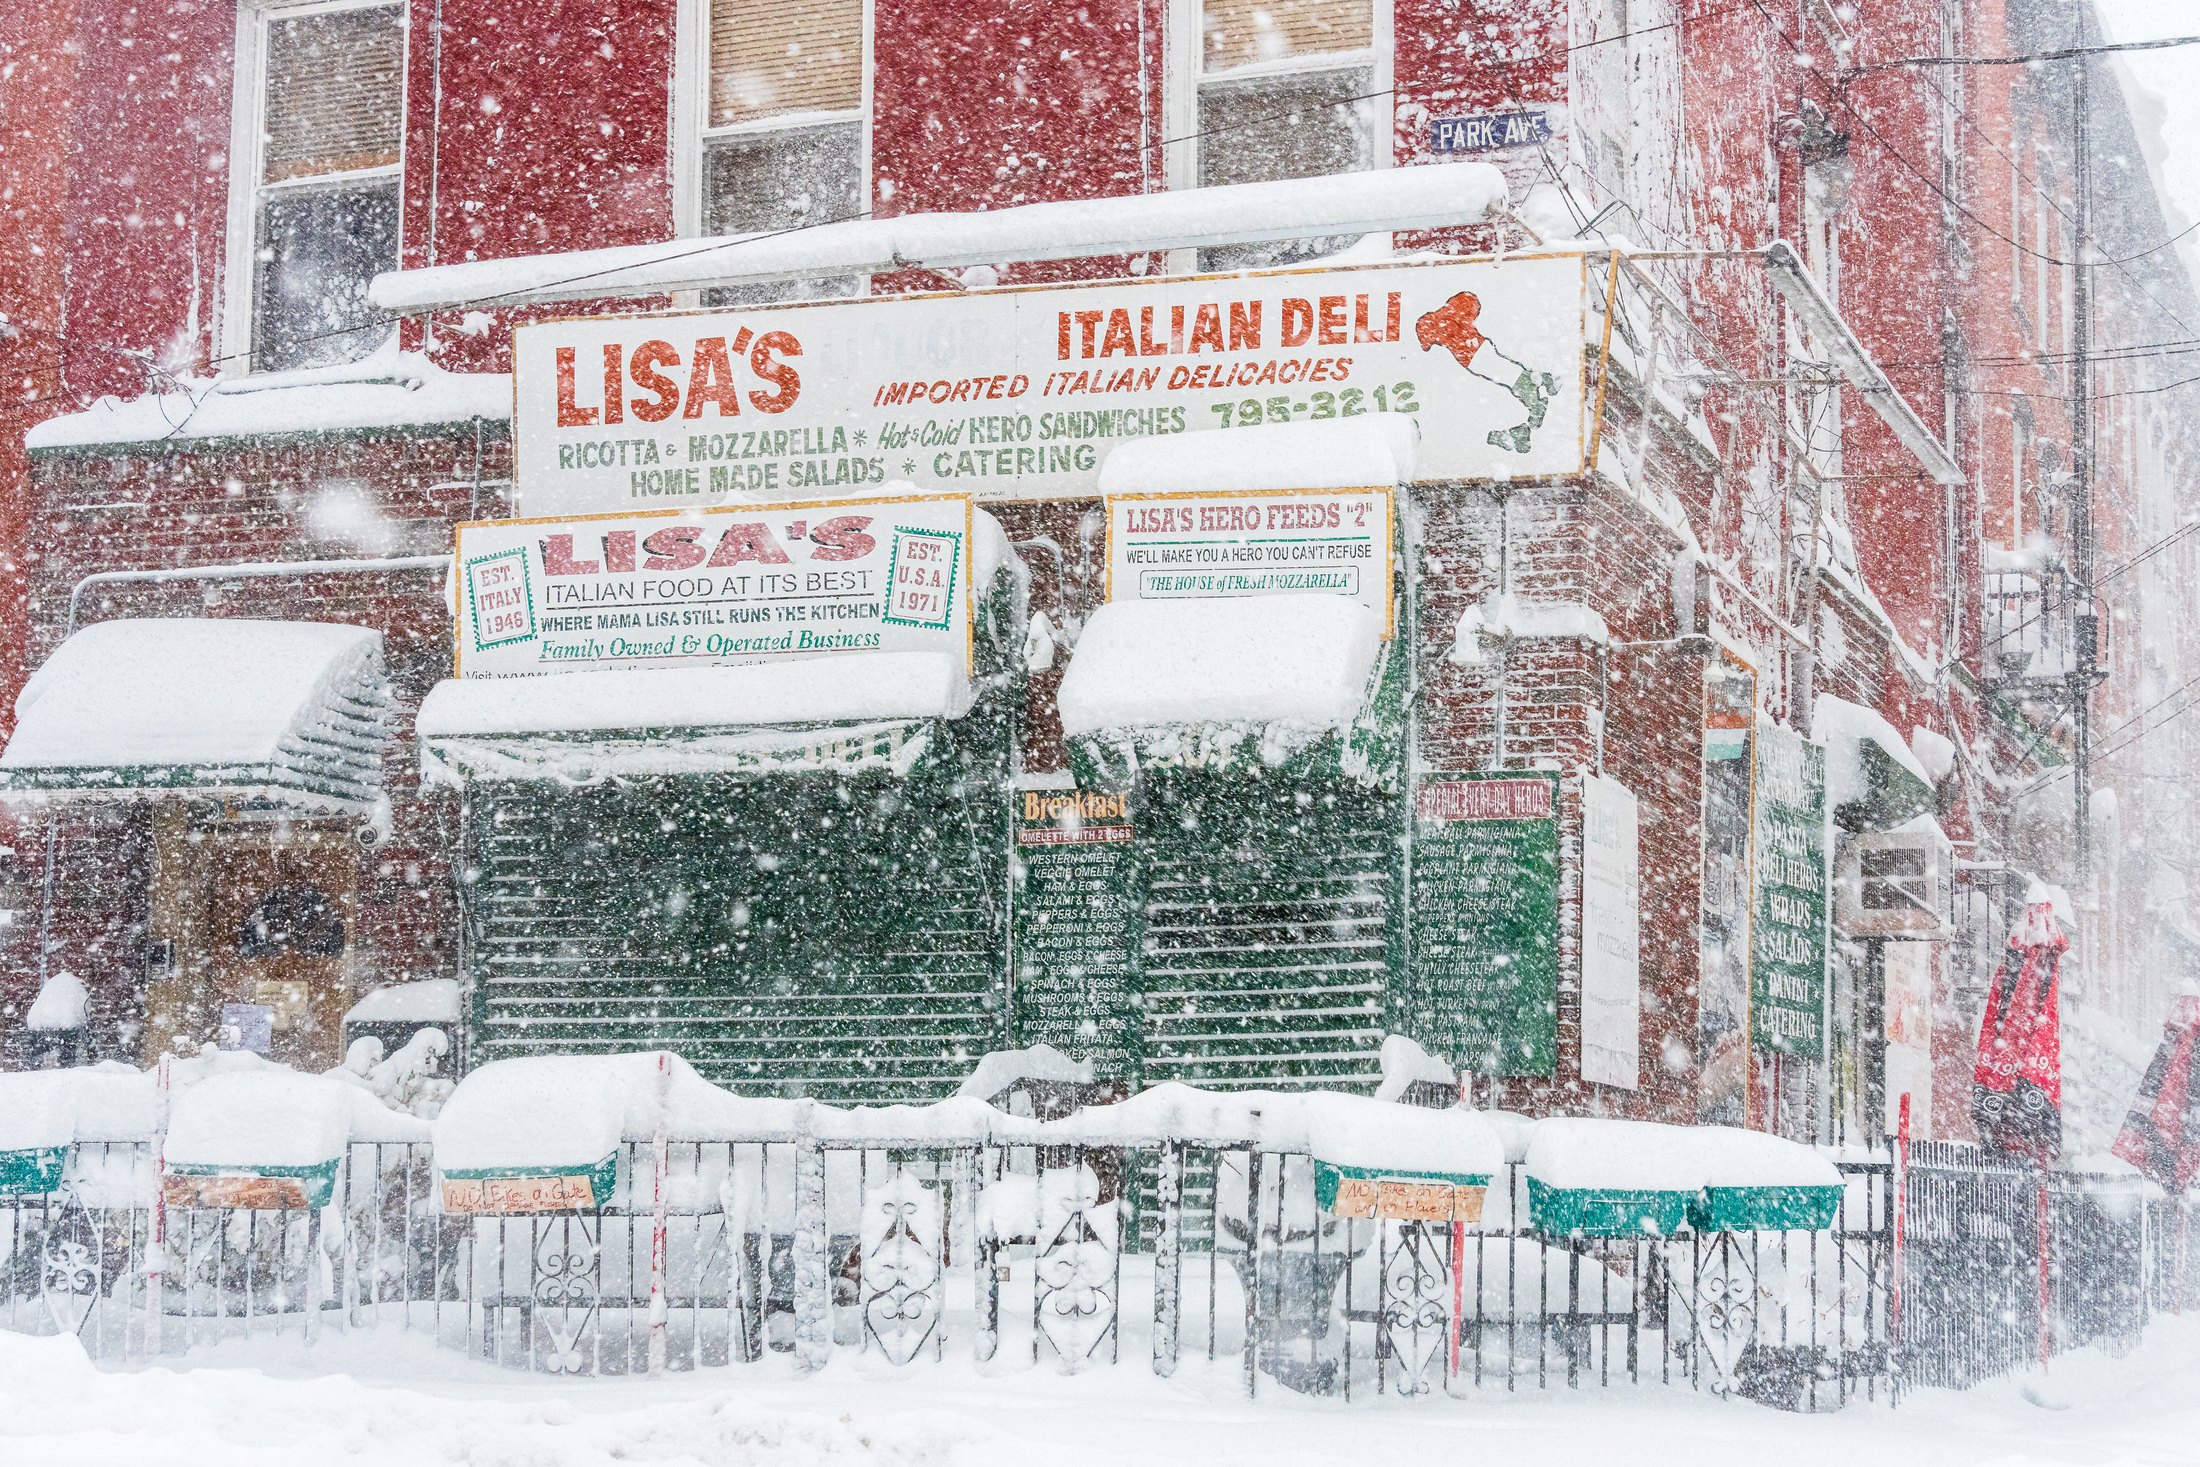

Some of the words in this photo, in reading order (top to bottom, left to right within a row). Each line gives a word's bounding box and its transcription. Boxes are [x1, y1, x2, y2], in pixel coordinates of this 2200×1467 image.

[1440, 120, 1495, 150] PARK
[1057, 299, 1263, 361] ITALIAN
[1280, 291, 1402, 348] DELI
[556, 325, 804, 428] LISA'S
[873, 374, 1030, 408] IMPORTED
[1043, 365, 1161, 397] ITALIAN
[1167, 356, 1354, 391] DELICACIES
[1210, 380, 1421, 430] 795-3212
[969, 414, 1033, 445] HERO
[1038, 405, 1187, 442] SANDWICHES
[558, 438, 661, 470] RICOTTA
[666, 442, 678, 457] &
[688, 425, 849, 463] MOZZARELLA
[933, 443, 1097, 479] CATERING
[630, 467, 700, 499] HOME
[709, 461, 779, 494] MADE
[786, 455, 886, 489] SALADS
[1126, 506, 1194, 534] LISA'S
[1199, 504, 1261, 532] HERO
[1266, 502, 1341, 530] FEEDS
[538, 515, 877, 577] LISA'S
[906, 541, 942, 563] EST.
[1126, 549, 1159, 564] WE'LL
[1161, 548, 1193, 563] MAKE
[1195, 547, 1218, 563] YOU
[1221, 548, 1230, 562] A
[1232, 546, 1263, 562] HERO
[1266, 546, 1289, 561] YOU
[1291, 545, 1325, 560] CAN'T
[1327, 543, 1372, 559] REFUSE
[480, 564, 515, 588] EST.
[545, 581, 635, 604] ITALIAN
[642, 578, 714, 600] FOOD
[721, 576, 751, 596] AT
[760, 573, 798, 594] ITS
[805, 570, 874, 592] BEST
[898, 565, 945, 589] U.S.A.
[1174, 575, 1215, 591] HOUSE
[1216, 574, 1228, 593] of
[1227, 574, 1268, 590] FRESH
[479, 586, 522, 612] ITALY
[898, 591, 939, 613] 1971
[486, 610, 524, 636] 1946
[540, 614, 593, 633] WHERE
[597, 613, 642, 630] MAMA
[646, 611, 680, 627] LISA
[682, 608, 726, 626] STILL
[729, 606, 771, 625] RUNS
[775, 605, 807, 623] THE
[811, 601, 881, 621] KITCHEN
[539, 637, 604, 662] Family
[609, 634, 675, 658] Owned
[681, 634, 702, 654] &
[706, 630, 793, 657] Operated
[799, 628, 881, 649] Business
[1024, 790, 1127, 821] Breakfast
[1425, 787, 1461, 816] SPECIAL
[1463, 785, 1492, 815] EVERY
[1494, 785, 1512, 815] DAY
[1514, 784, 1545, 813] HEROS
[1021, 832, 1070, 844] OMELETTE
[1072, 830, 1096, 842] WITH
[1097, 830, 1104, 841] 2
[1773, 820, 1808, 857] PASTA
[1029, 854, 1079, 865] WESTERN
[1081, 852, 1123, 864] OMELET
[1419, 844, 1456, 857] SAUSAGE
[1034, 867, 1072, 879] VEGGIE
[1074, 866, 1116, 878] OMELET
[1763, 851, 1786, 884] DELI
[1786, 857, 1819, 894] HEROS
[1036, 895, 1073, 907] SALAMI
[1085, 894, 1115, 905] EGGS
[1418, 898, 1455, 911] CHICKEN
[1457, 898, 1489, 911] CHEESE
[1490, 898, 1517, 911] STEAK
[1769, 893, 1811, 930] WRAPS
[1032, 909, 1078, 921] PEPPERS
[1090, 908, 1119, 919] EGGS
[1026, 923, 1084, 934] PEPPERONI
[1095, 922, 1125, 932] EGGS
[1418, 927, 1449, 941] CHEESE
[1451, 927, 1478, 941] STEAK
[1037, 937, 1073, 948] BACON
[1085, 936, 1114, 946] EGGS
[1451, 945, 1477, 959] STEAK
[1768, 930, 1812, 967] SALADS
[1059, 950, 1083, 961] EGGS
[1093, 949, 1128, 961] CHEESE
[1049, 965, 1079, 976] EGGS
[1087, 963, 1124, 975] CHEESE
[1418, 962, 1446, 975] PHILLY
[1030, 979, 1075, 990] SPINACH
[1087, 978, 1116, 988] EGGS
[1418, 979, 1435, 992] HOT
[1437, 978, 1465, 992] ROAST
[1466, 978, 1487, 992] BEEF
[1768, 971, 1809, 1004] PANINI
[1022, 993, 1085, 1004] MUSHROOMS
[1097, 992, 1125, 1002] EGGS
[1417, 997, 1435, 1010] HOT
[1437, 997, 1469, 1010] TURKEY
[1039, 1006, 1072, 1017] STEAK
[1083, 1005, 1111, 1016] EGGS
[1759, 1004, 1816, 1040] CATERING
[1098, 1019, 1127, 1031] EGGS
[1031, 1034, 1072, 1045] ITALIAN
[1088, 1048, 1130, 1060] SALMON
[450, 1186, 482, 1207] NO
[551, 1182, 588, 1201] Gate
[1345, 1182, 1371, 1201] NO
[1416, 1187, 1431, 1197] on
[1405, 1200, 1450, 1213] Flowers
